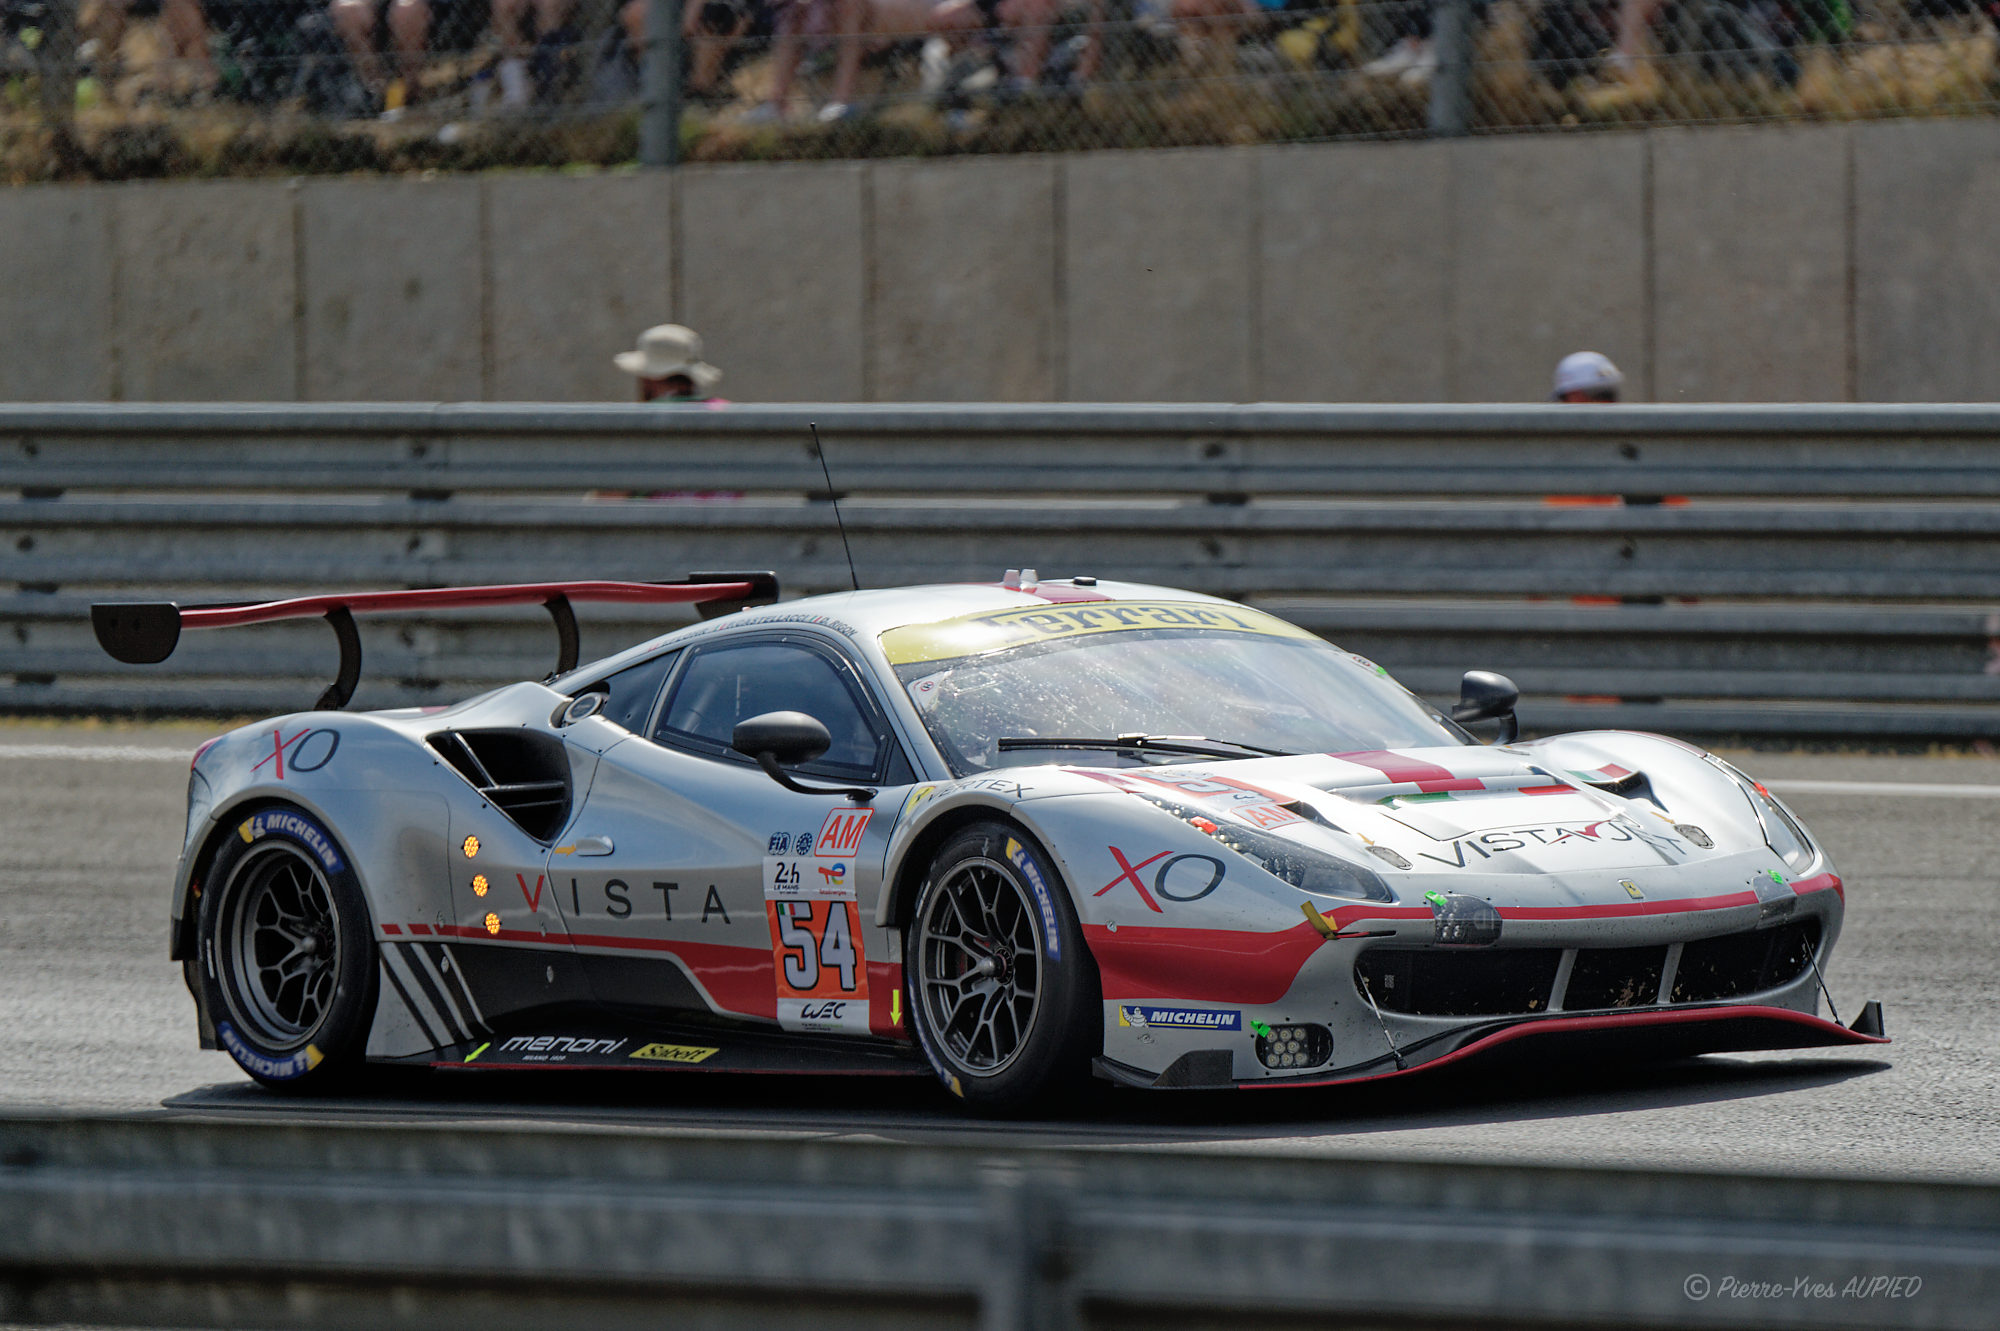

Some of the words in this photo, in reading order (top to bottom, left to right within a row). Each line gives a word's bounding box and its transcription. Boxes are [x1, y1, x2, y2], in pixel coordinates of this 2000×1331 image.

[250, 728, 341, 780] XO
[266, 813, 338, 867] MICHELIN
[768, 836, 787, 852] FIA
[819, 814, 868, 849] AM
[516, 872, 731, 925] VISTA
[1092, 845, 1226, 914] XO
[1023, 861, 1058, 953] MICHELIN
[776, 900, 857, 992] 54
[800, 1001, 847, 1020] WEC
[1150, 1010, 1236, 1026] MICHELIN
[222, 1029, 295, 1077] MICHELIN
[499, 1036, 629, 1054] menoni
